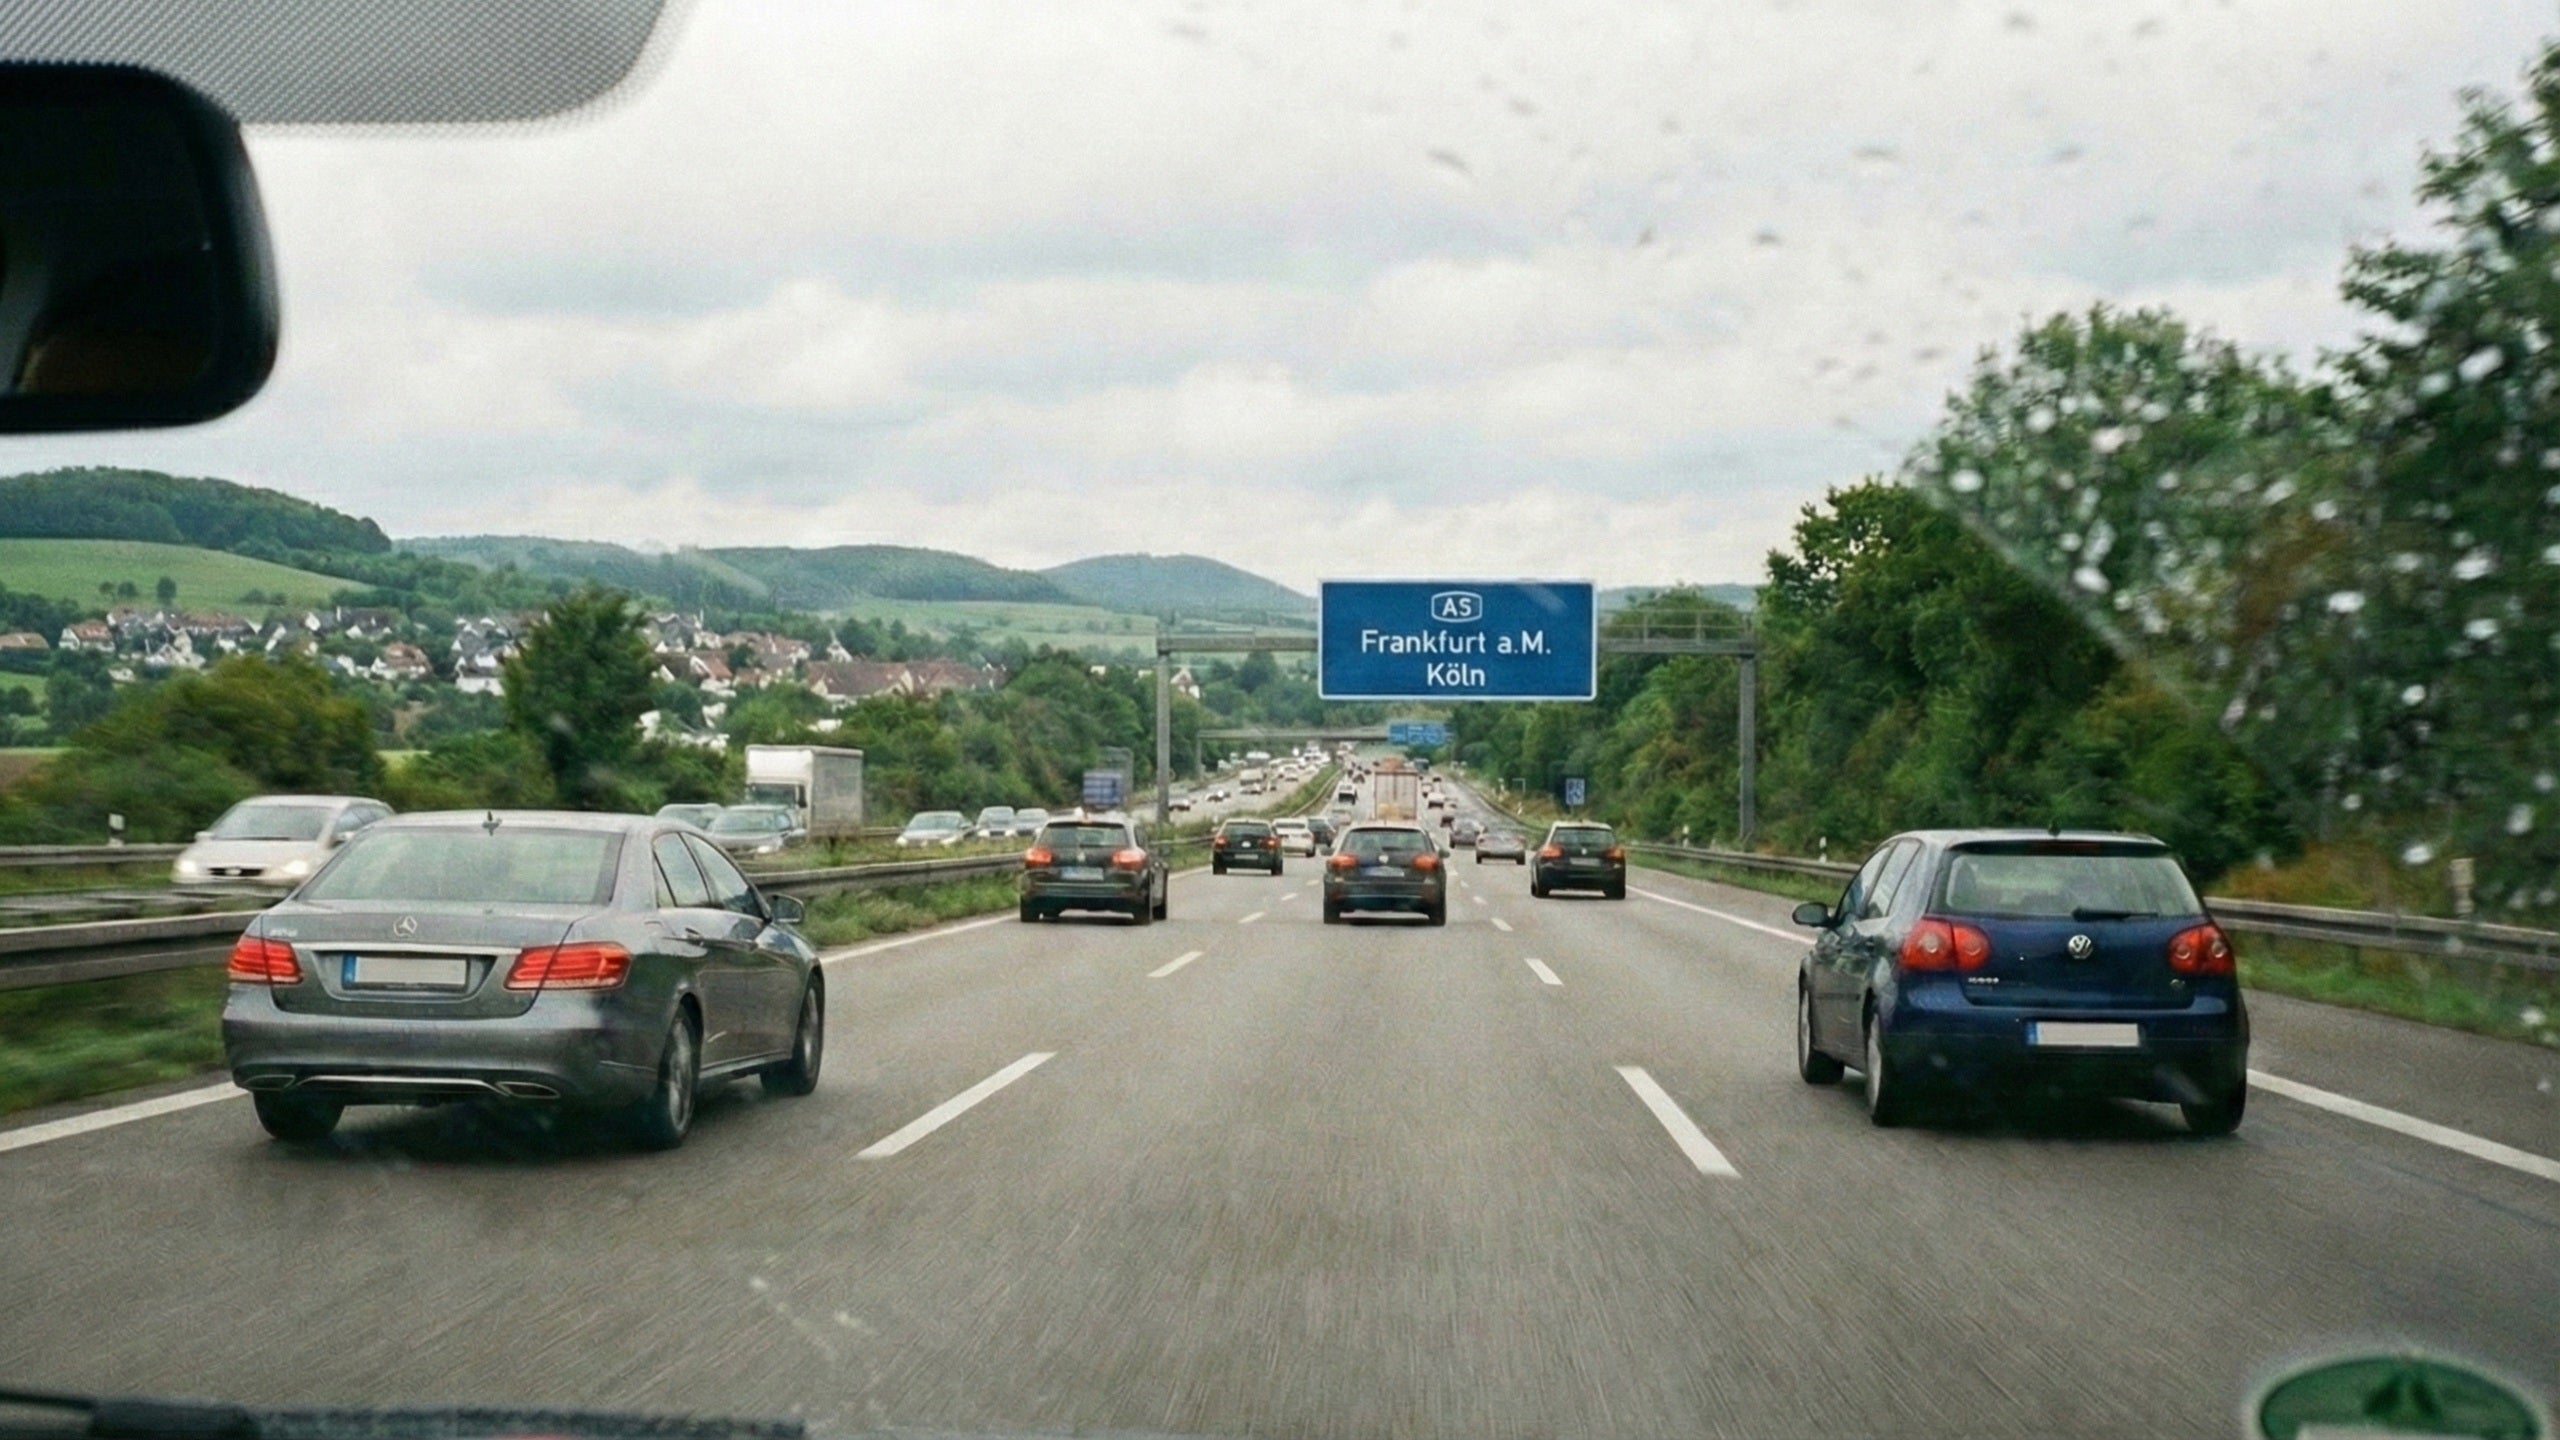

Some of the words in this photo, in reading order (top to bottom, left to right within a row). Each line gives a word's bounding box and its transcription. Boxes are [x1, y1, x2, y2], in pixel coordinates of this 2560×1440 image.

[1442, 598, 1472, 617] AS
[1361, 631, 1486, 654] Frankfurt
[1497, 631, 1552, 655] a.M.
[1427, 662, 1486, 686] Köln
